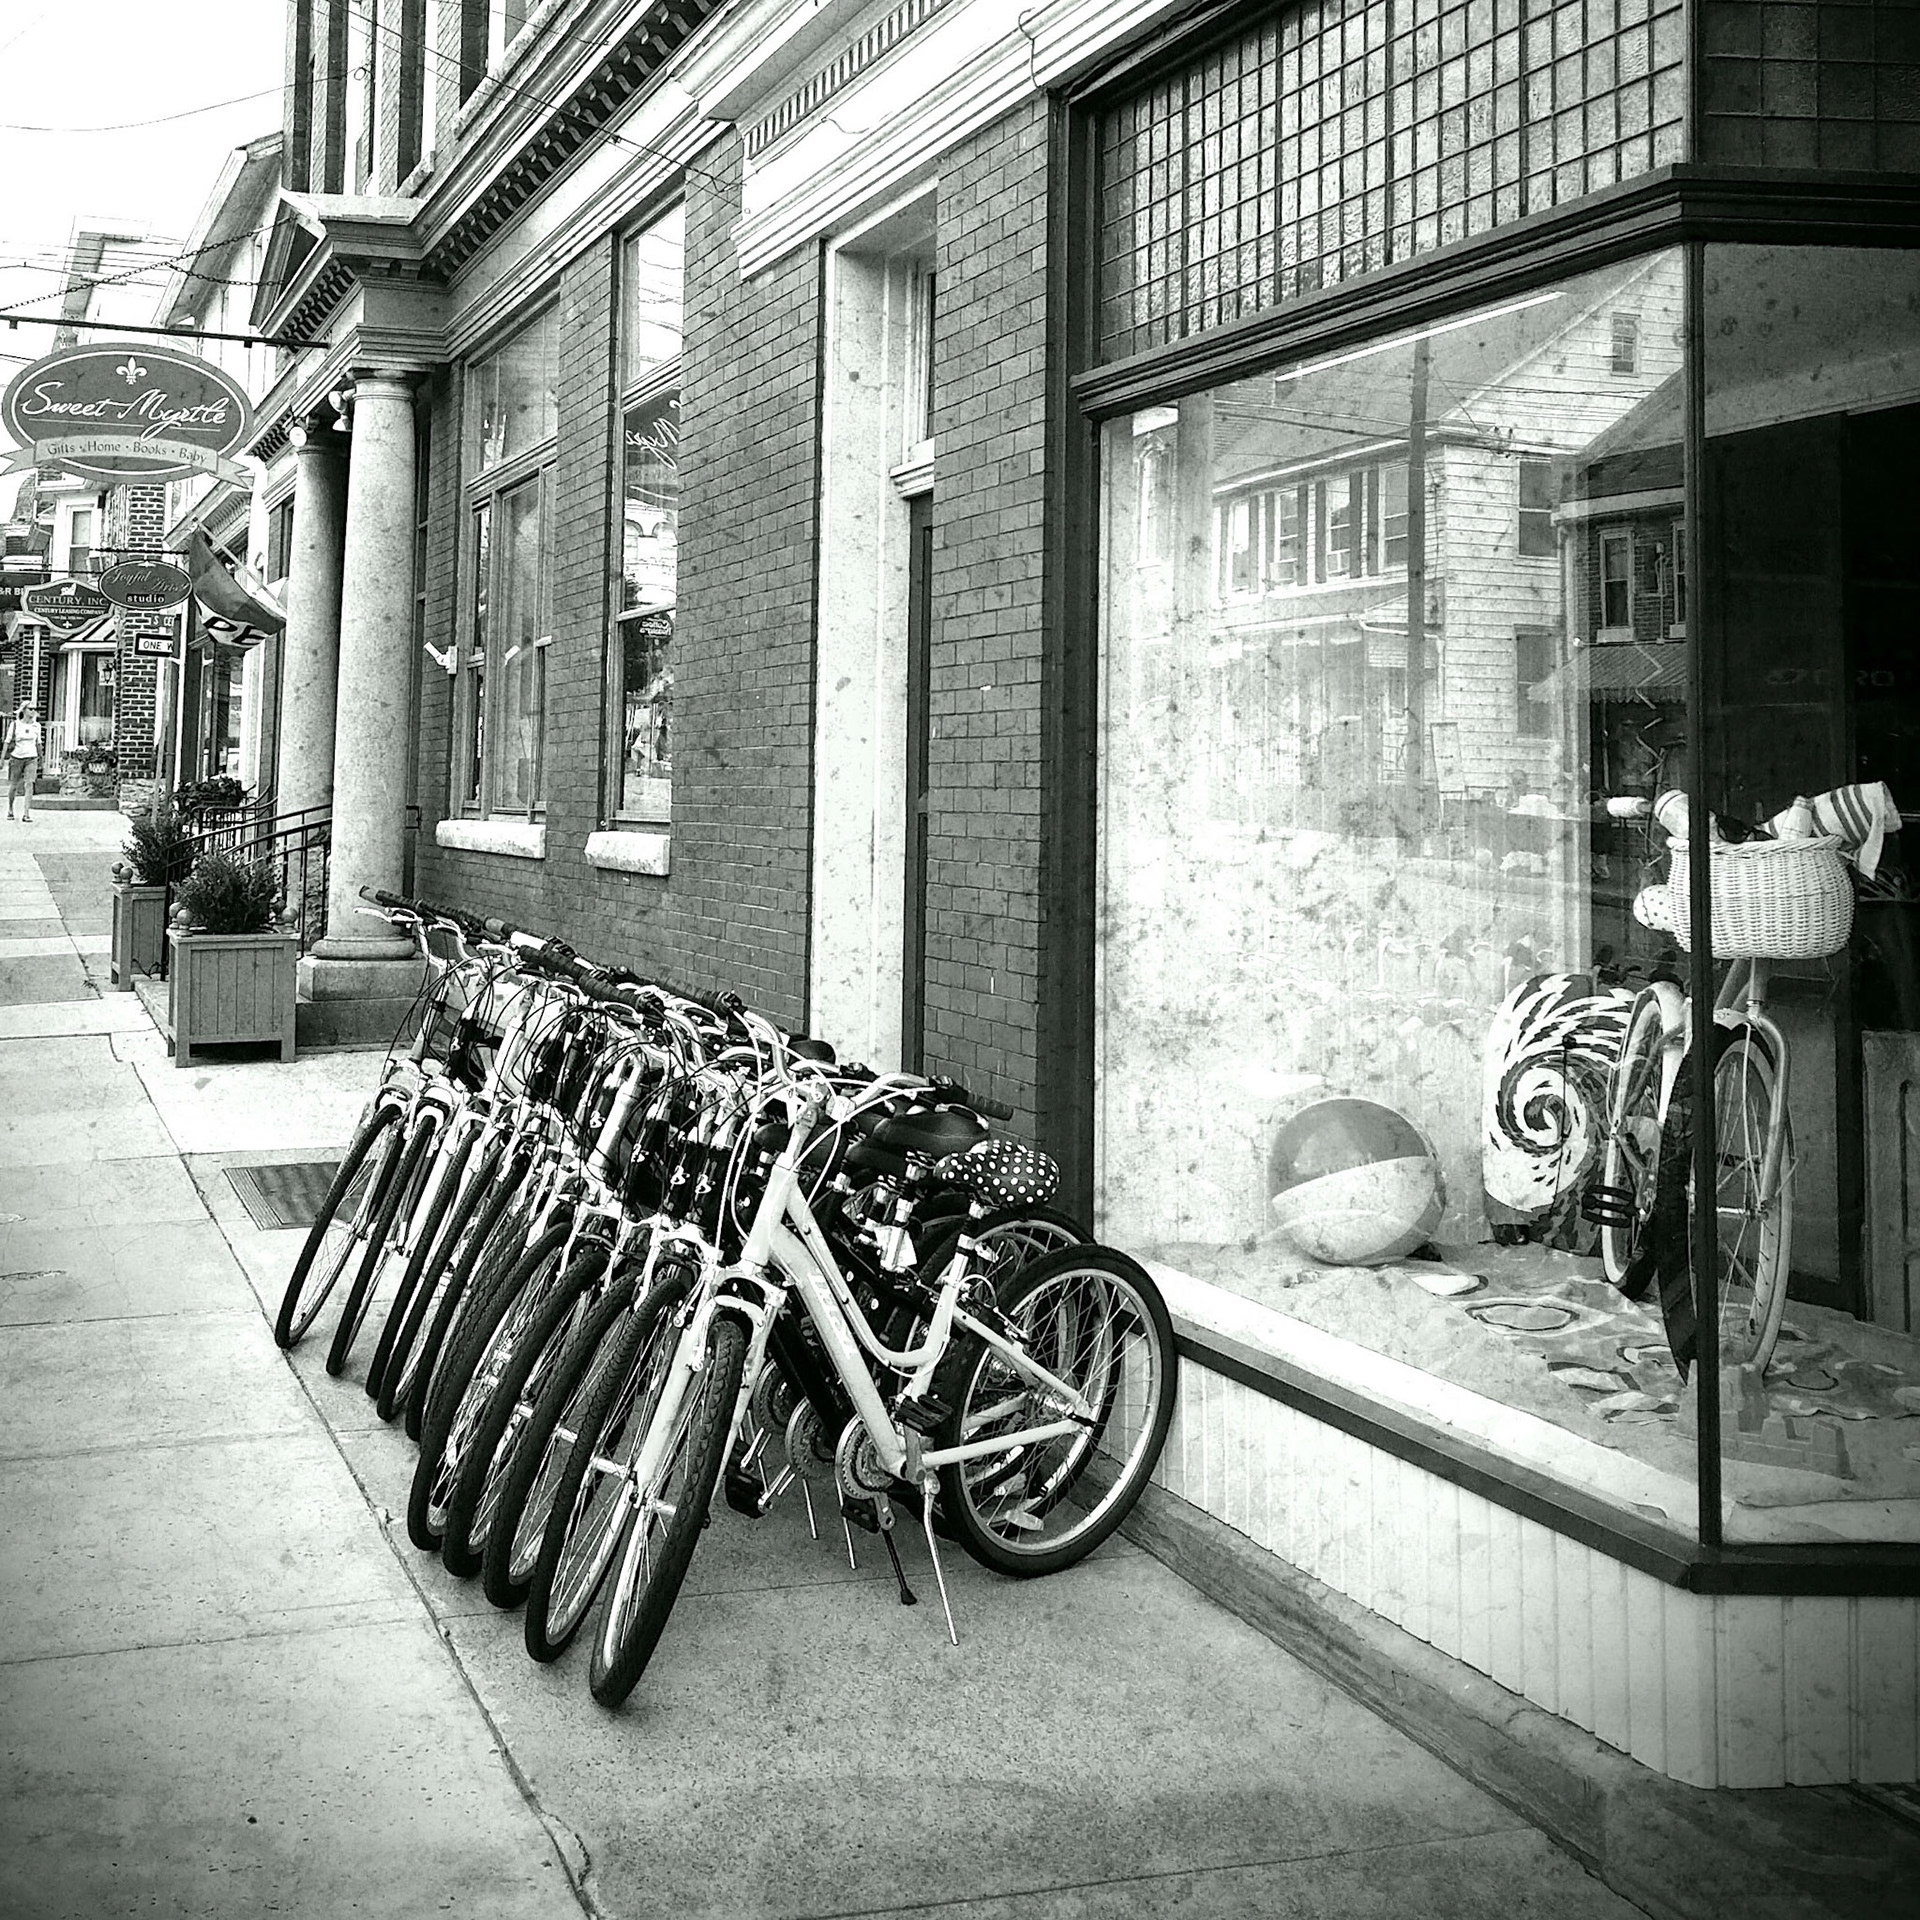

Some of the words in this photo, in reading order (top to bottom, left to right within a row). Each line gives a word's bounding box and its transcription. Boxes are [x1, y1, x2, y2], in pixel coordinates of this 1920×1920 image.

[20, 381, 114, 416] Sweet
[118, 388, 230, 441] Myrtle
[47, 442, 75, 455] Gifts
[87, 440, 121, 452] Home
[133, 441, 167, 455] Books
[179, 447, 207, 463] Baby
[107, 568, 151, 586] Joyful
[127, 594, 165, 603] studio
[143, 640, 162, 651] ONE
